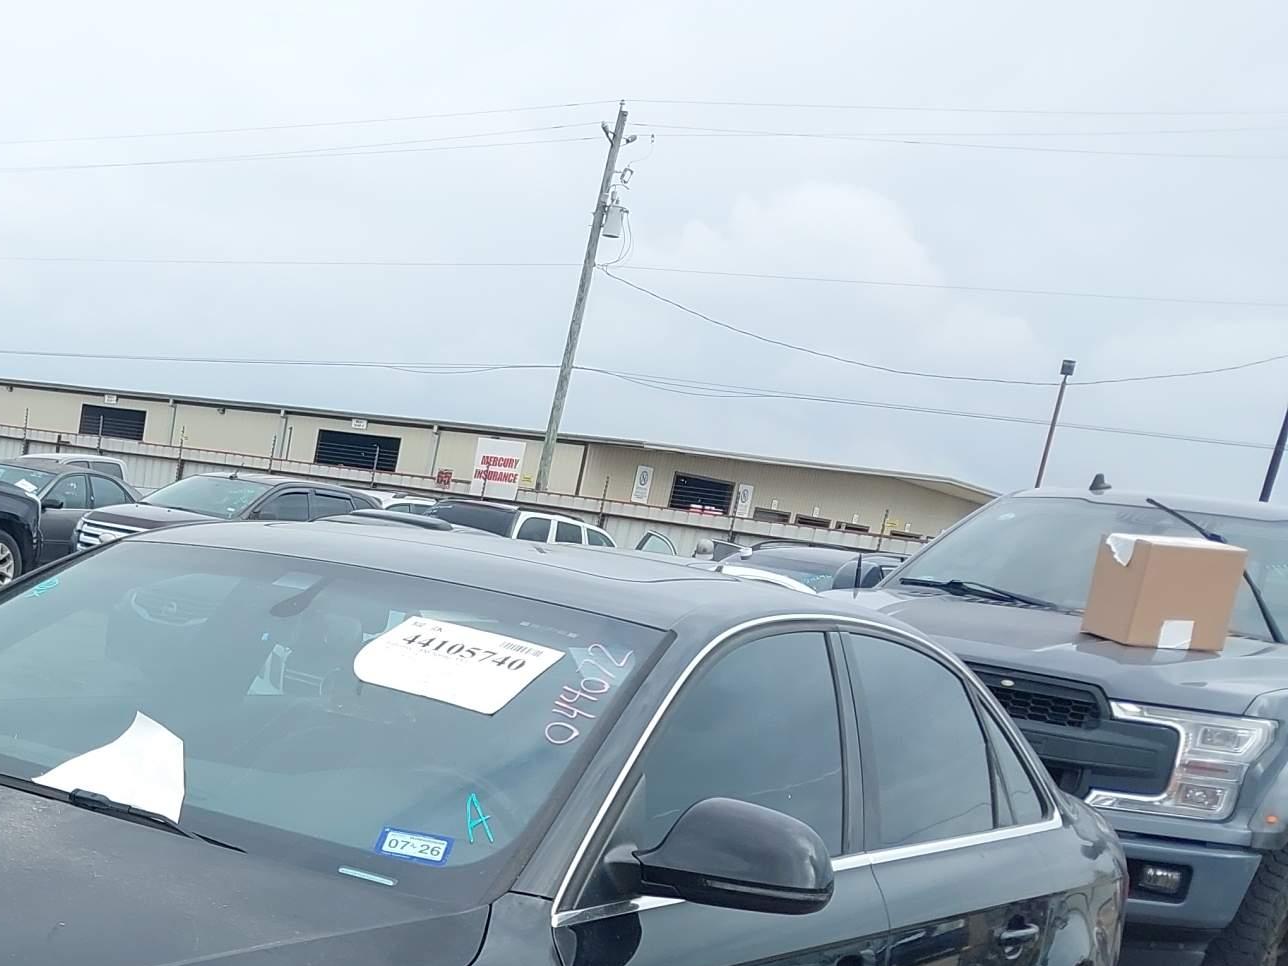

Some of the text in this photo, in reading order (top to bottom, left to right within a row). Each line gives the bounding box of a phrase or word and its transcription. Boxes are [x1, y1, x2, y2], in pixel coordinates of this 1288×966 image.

[474, 468, 519, 484] INSURANCE
[481, 456, 519, 469] MERCURY
[402, 634, 526, 671] 44105740
[544, 643, 633, 744] 044072
[466, 792, 494, 844] A
